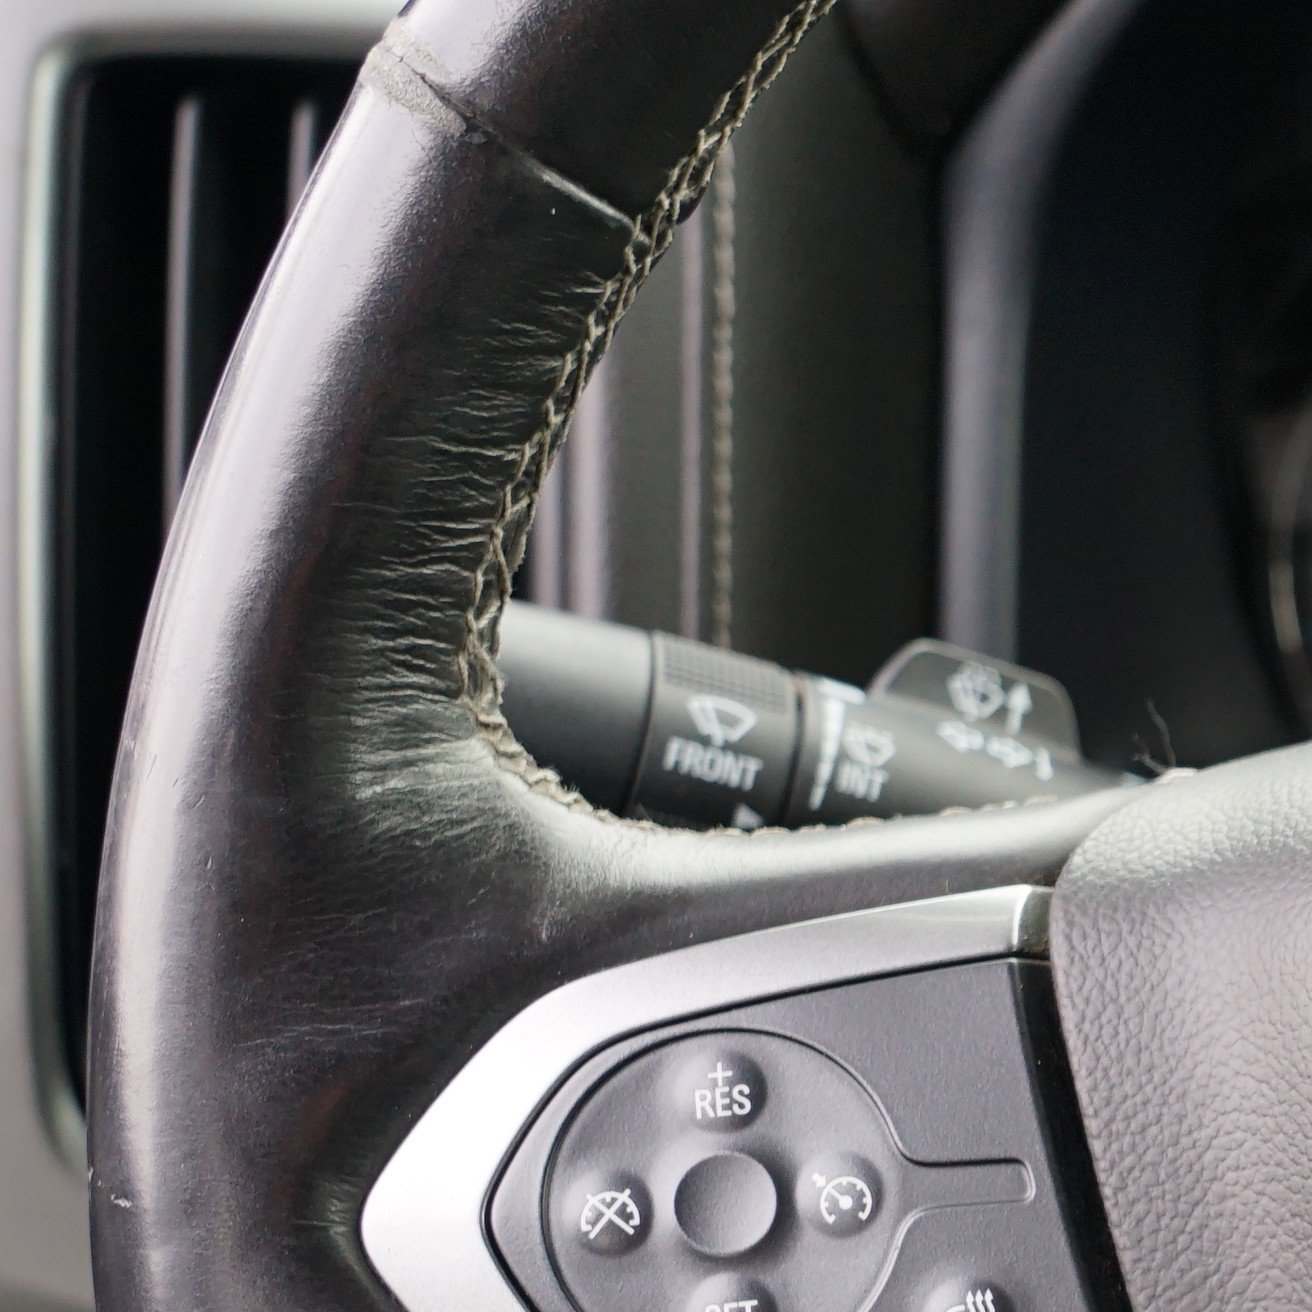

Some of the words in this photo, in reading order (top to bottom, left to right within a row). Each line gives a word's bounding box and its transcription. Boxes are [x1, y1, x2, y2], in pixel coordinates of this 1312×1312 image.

[663, 735, 764, 791] FRONT
[834, 758, 889, 803] INT
[695, 1085, 751, 1119] RES
